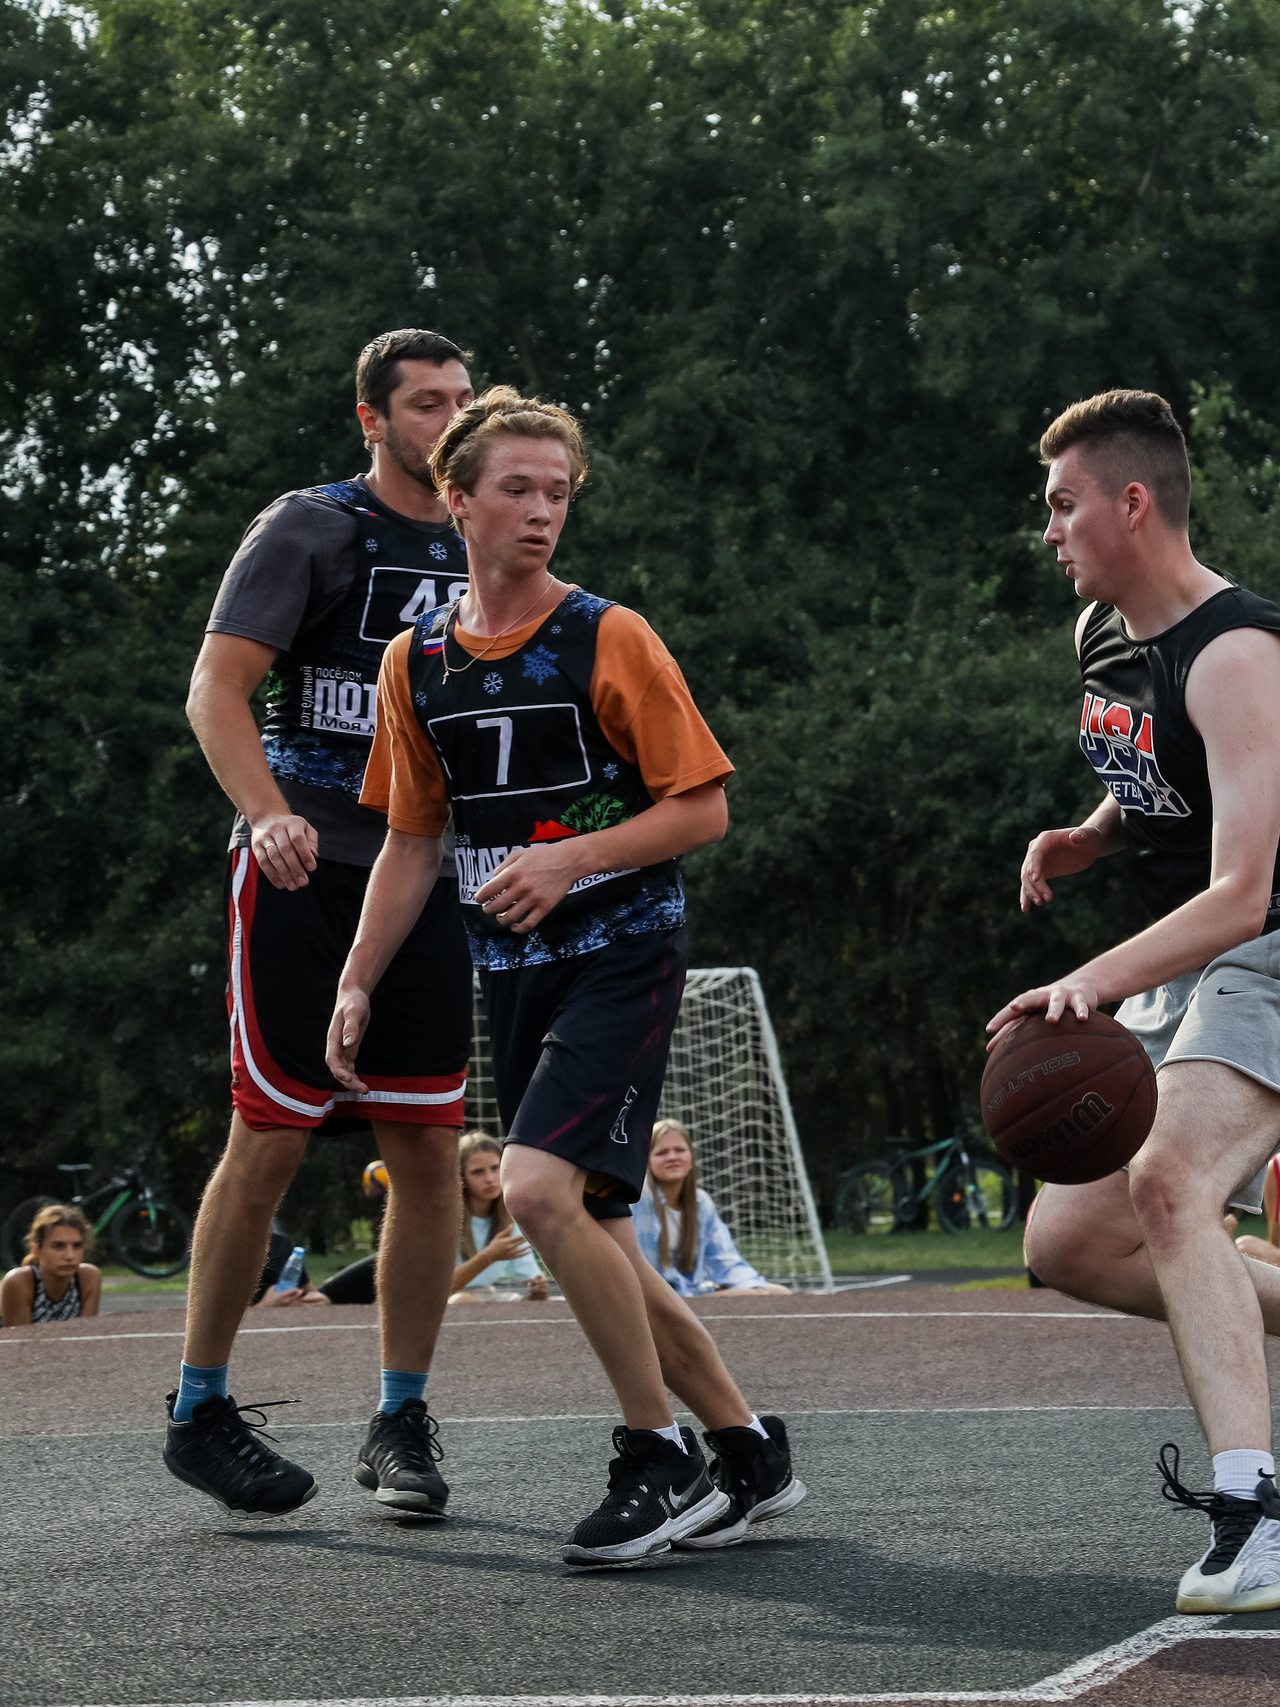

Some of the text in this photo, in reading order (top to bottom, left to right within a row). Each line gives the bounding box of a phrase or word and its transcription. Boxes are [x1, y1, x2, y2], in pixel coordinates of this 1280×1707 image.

[316, 666, 362, 681] посёлок
[320, 715, 361, 731] Моя
[476, 716, 513, 786] 7
[1079, 691, 1170, 790] USA
[987, 1051, 1081, 1112] SOLUTION
[1009, 1091, 1115, 1160] Wilson
